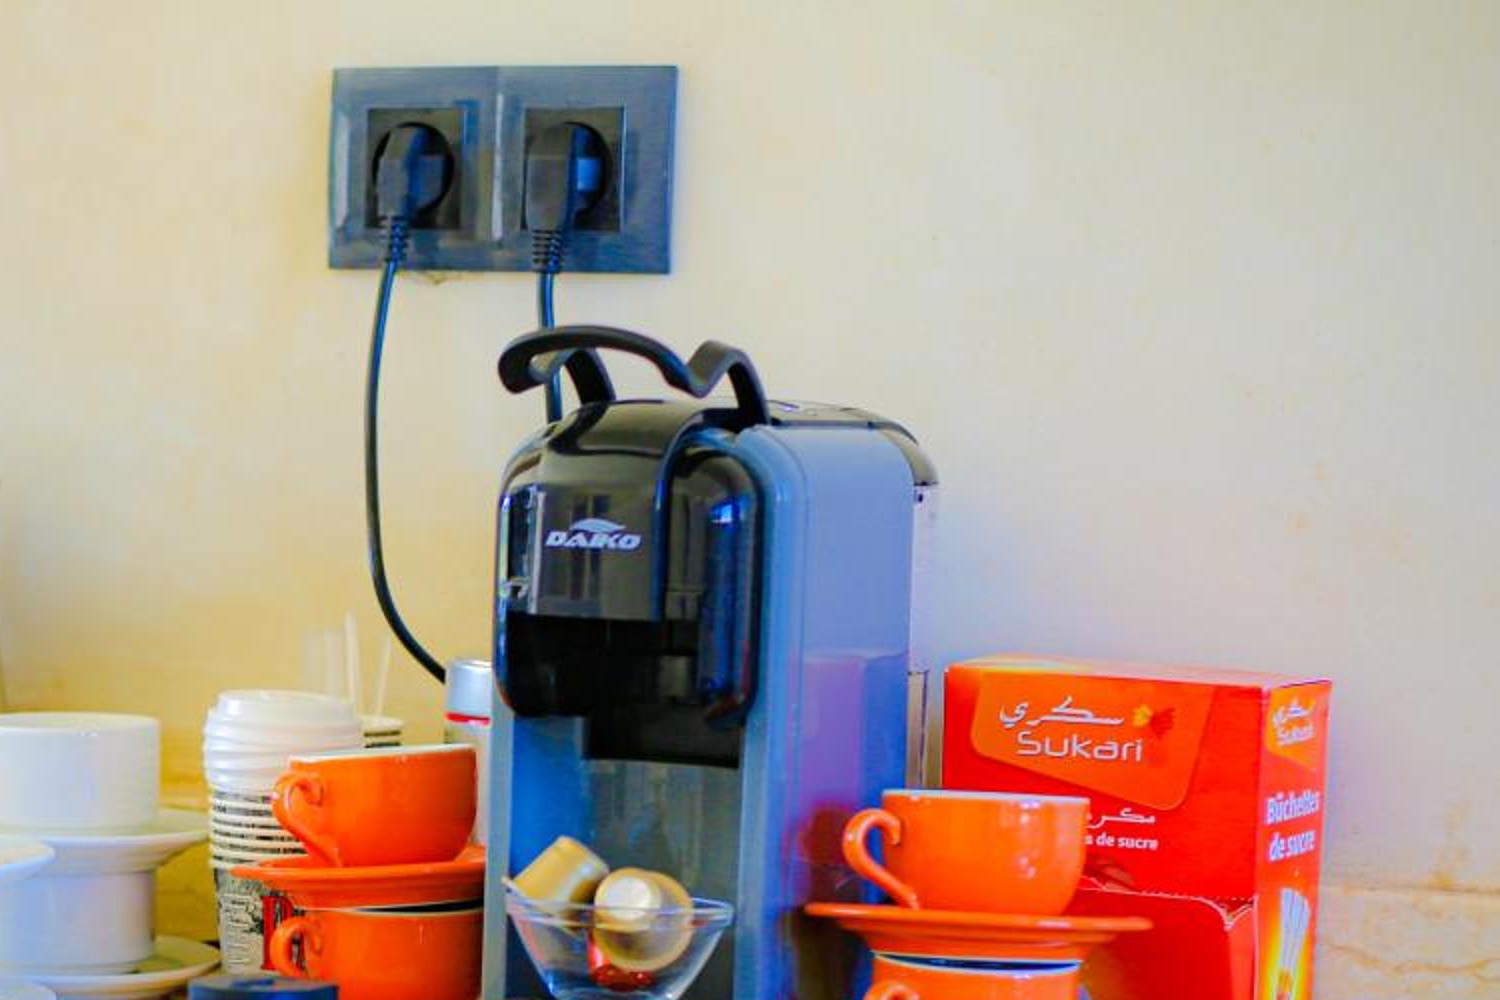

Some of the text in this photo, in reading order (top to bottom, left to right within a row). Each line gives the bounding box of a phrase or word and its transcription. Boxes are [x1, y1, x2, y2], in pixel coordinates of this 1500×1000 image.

[998, 695, 1125, 729] سكري
[1016, 730, 1144, 762] Sukari
[1116, 836, 1159, 851] sucre
